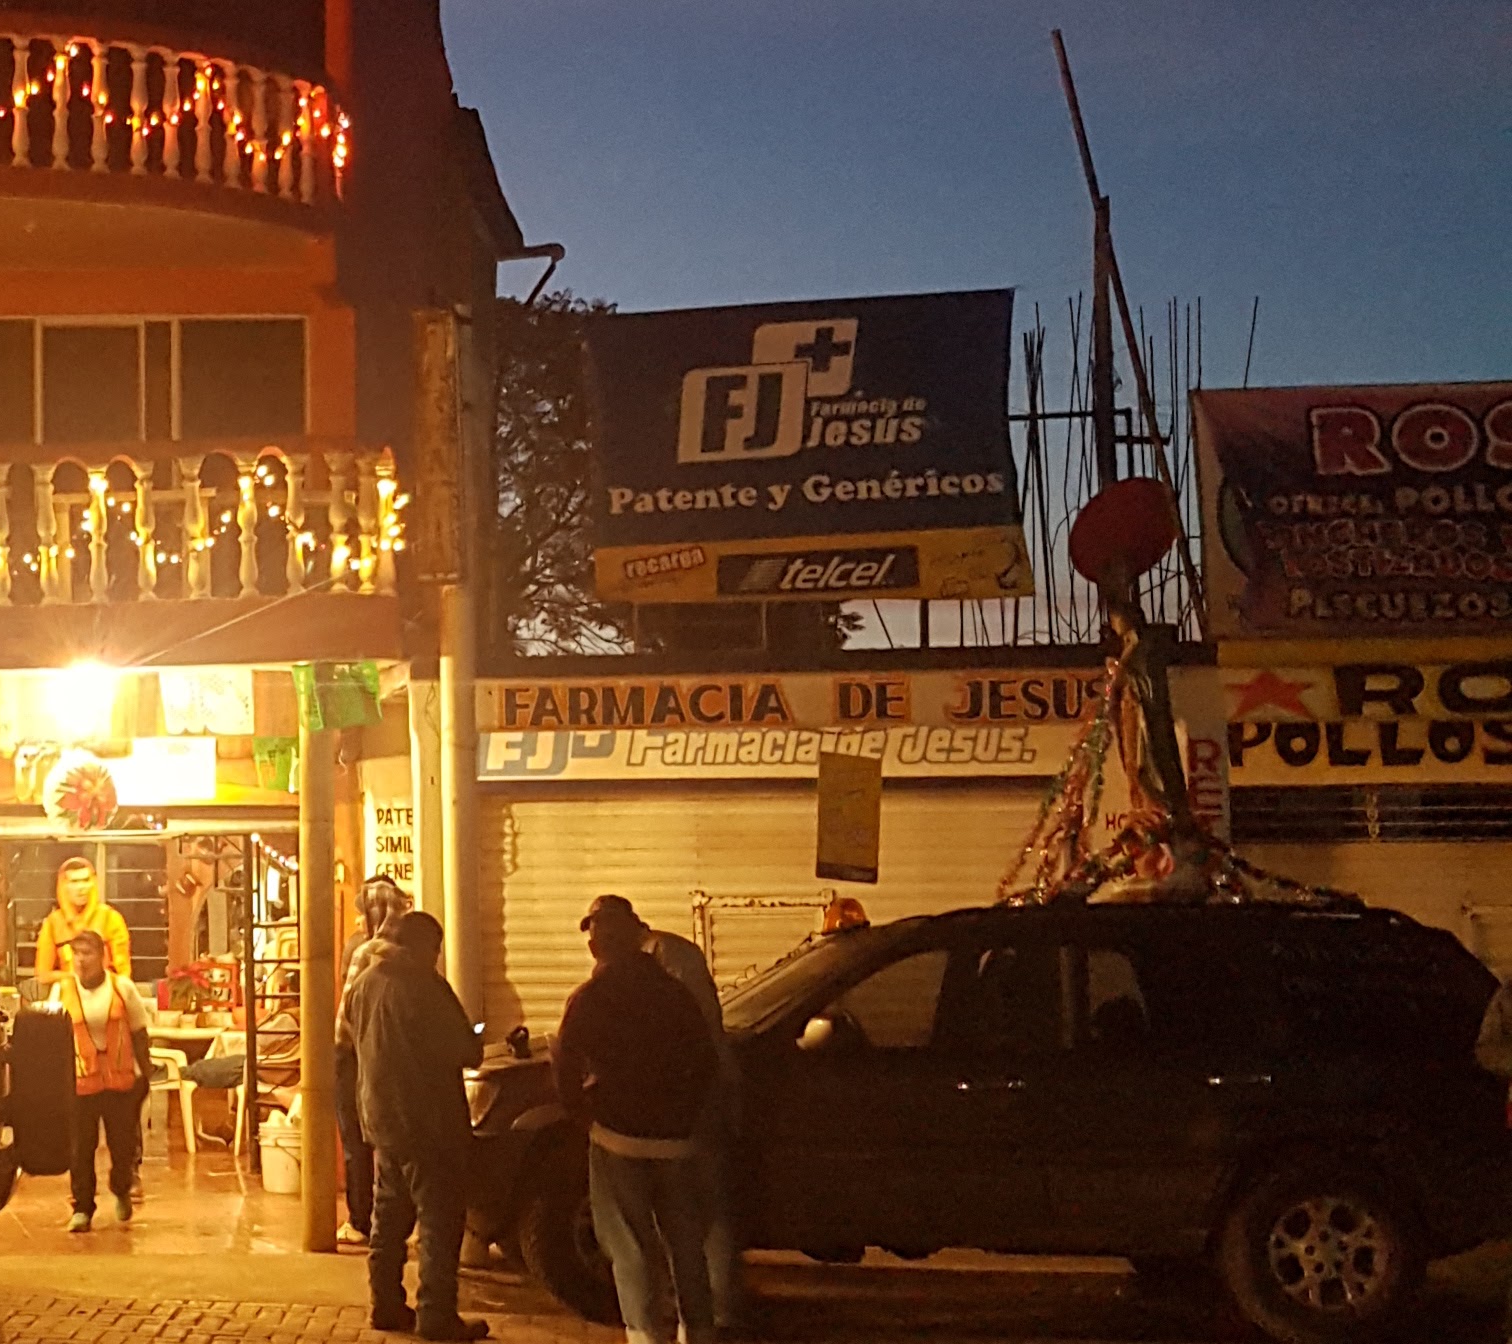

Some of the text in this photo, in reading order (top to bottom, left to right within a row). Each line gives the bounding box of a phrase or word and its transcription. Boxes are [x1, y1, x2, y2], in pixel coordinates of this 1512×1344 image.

[701, 372, 784, 454] FJ
[901, 396, 928, 413] de
[607, 467, 1005, 515] Patente y Genéricos
[626, 547, 705, 579] recarga
[780, 553, 897, 591] telcel
[503, 683, 790, 727] FARMACIA
[837, 679, 905, 720] DE
[626, 728, 821, 766] Farmacia
[1227, 720, 1512, 767] POLLOS
